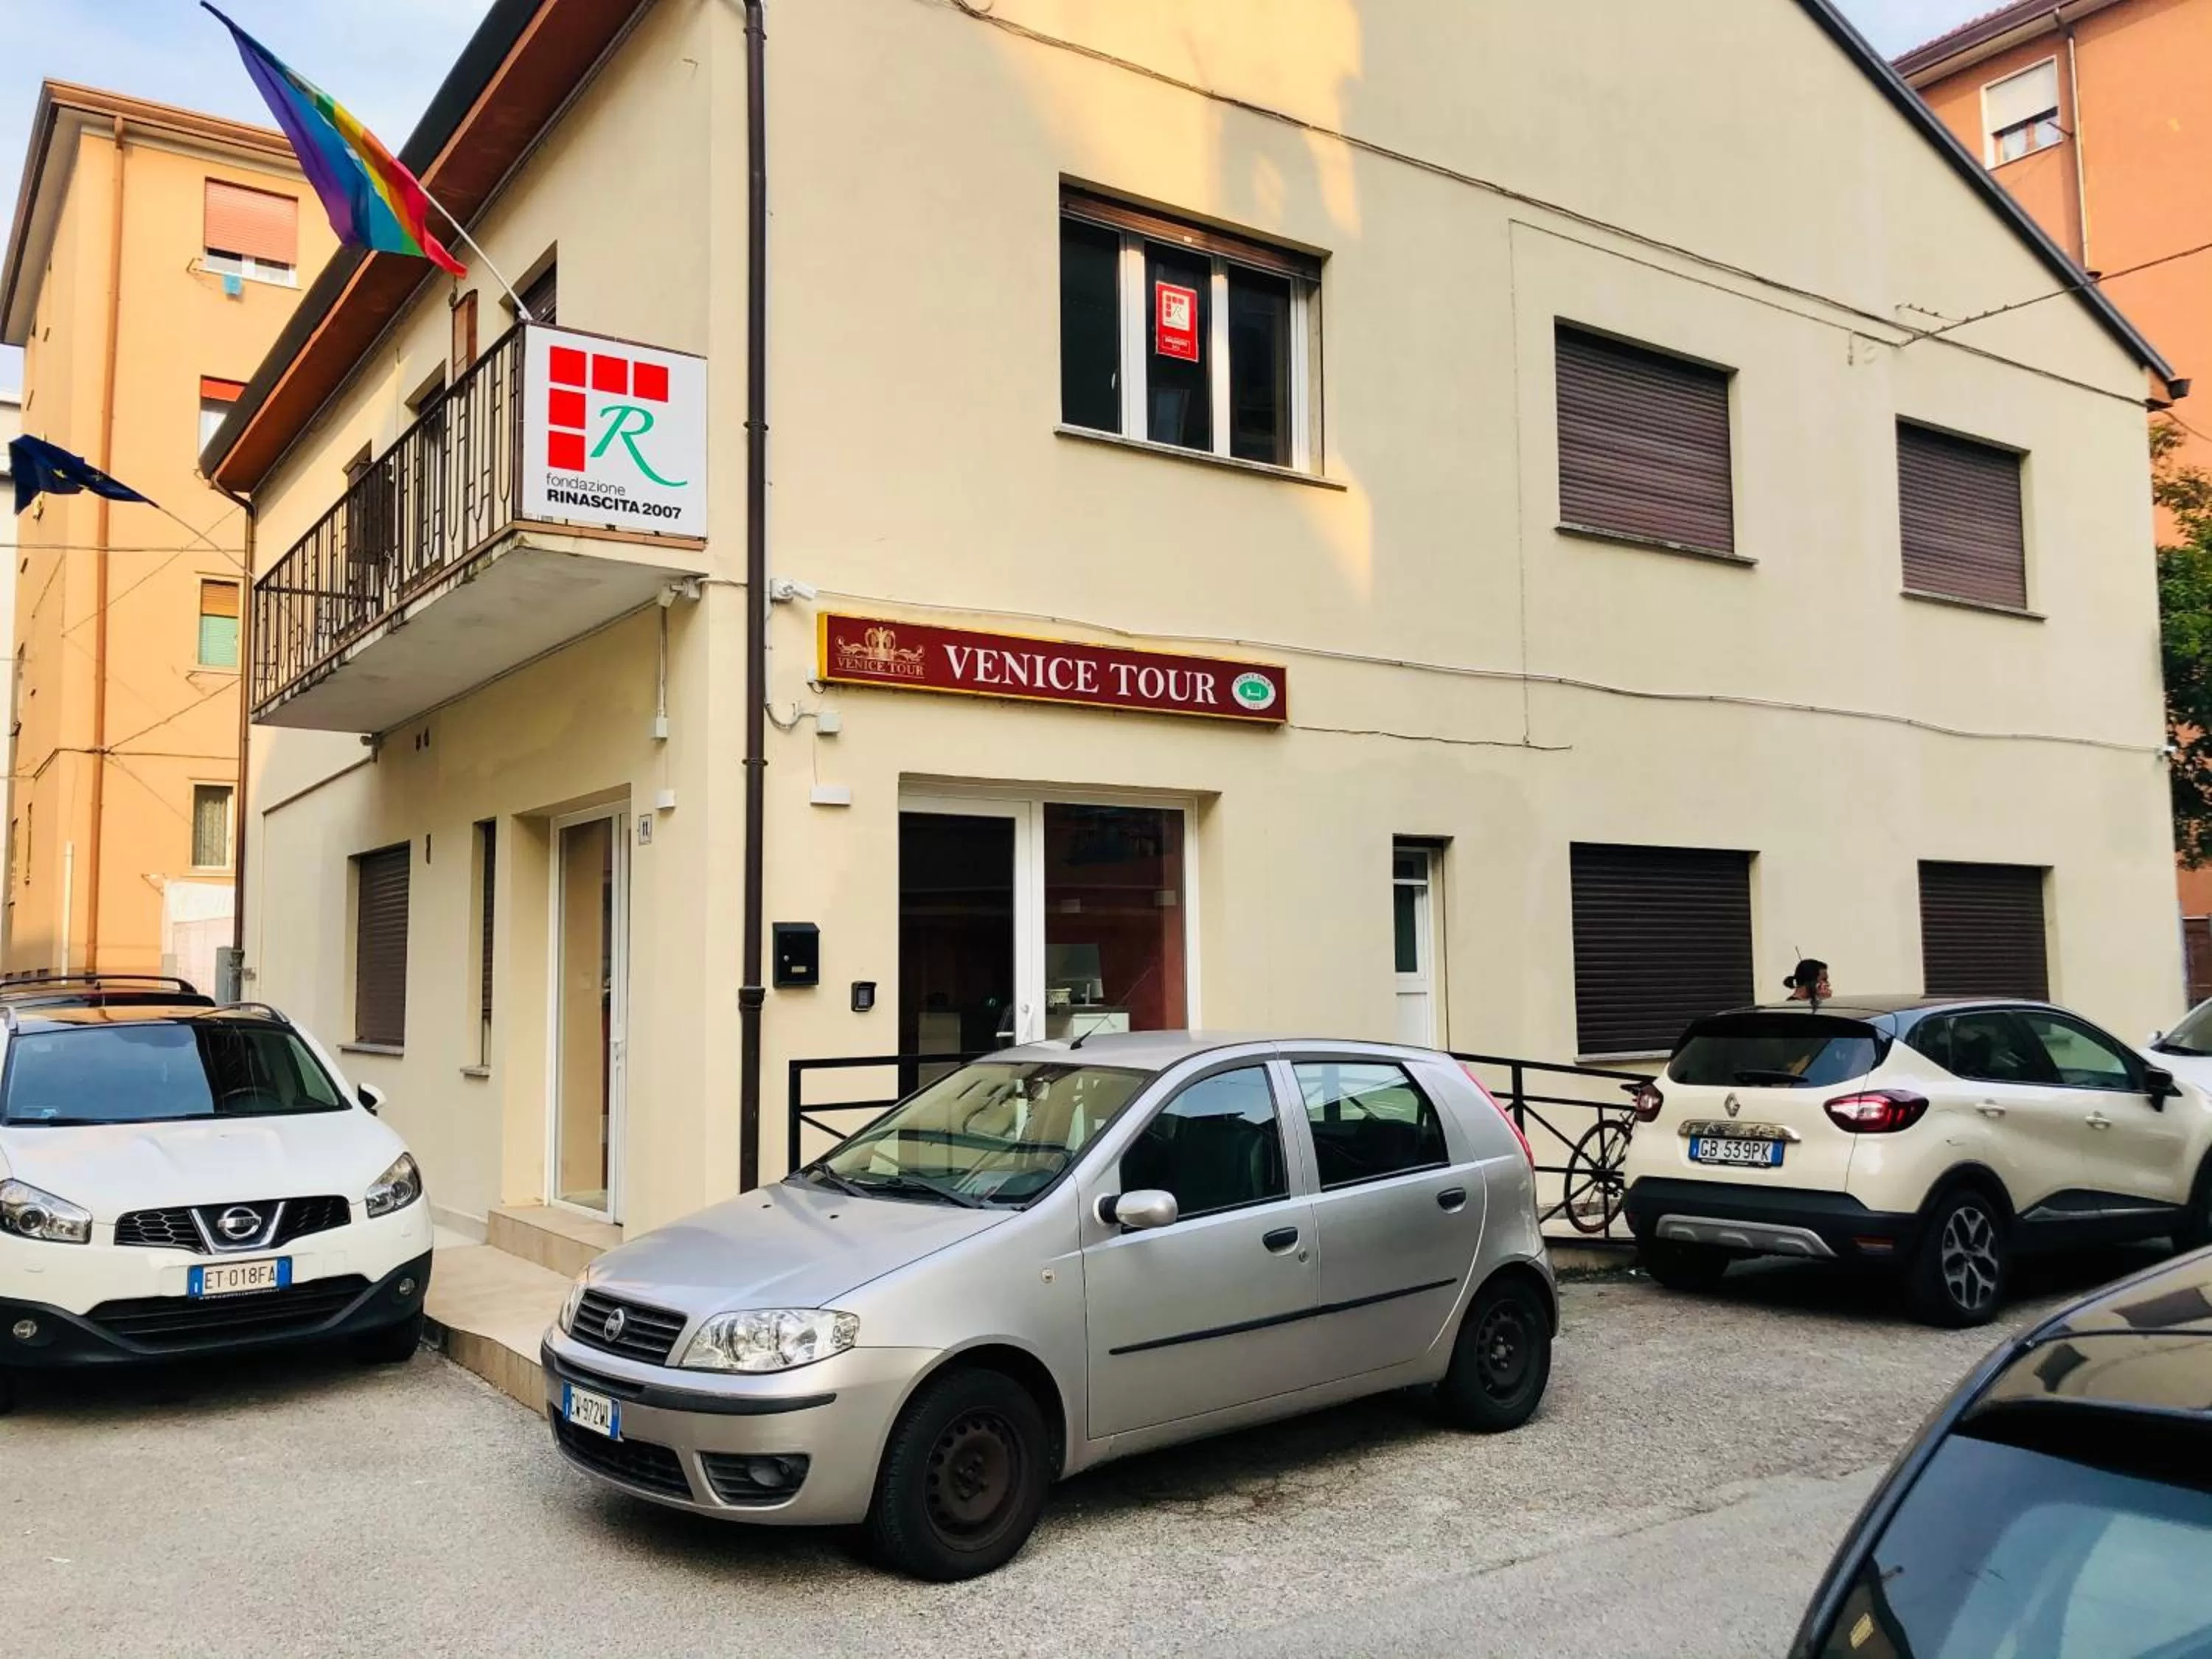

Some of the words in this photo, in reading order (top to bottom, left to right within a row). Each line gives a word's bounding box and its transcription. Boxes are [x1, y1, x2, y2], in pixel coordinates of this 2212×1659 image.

[589, 405, 688, 487] R
[546, 472, 626, 496] fondazione
[546, 489, 639, 514] RINASCITA
[642, 502, 682, 520] 2007
[837, 656, 886, 672] VENICE
[887, 660, 924, 676] TOUR
[943, 644, 1099, 694] VENICE
[1109, 663, 1218, 704] TOUR
[1700, 1139, 1719, 1157] GB
[1723, 1141, 1770, 1161] 539PK
[205, 1270, 224, 1290] ET
[229, 1266, 275, 1287] 018FA
